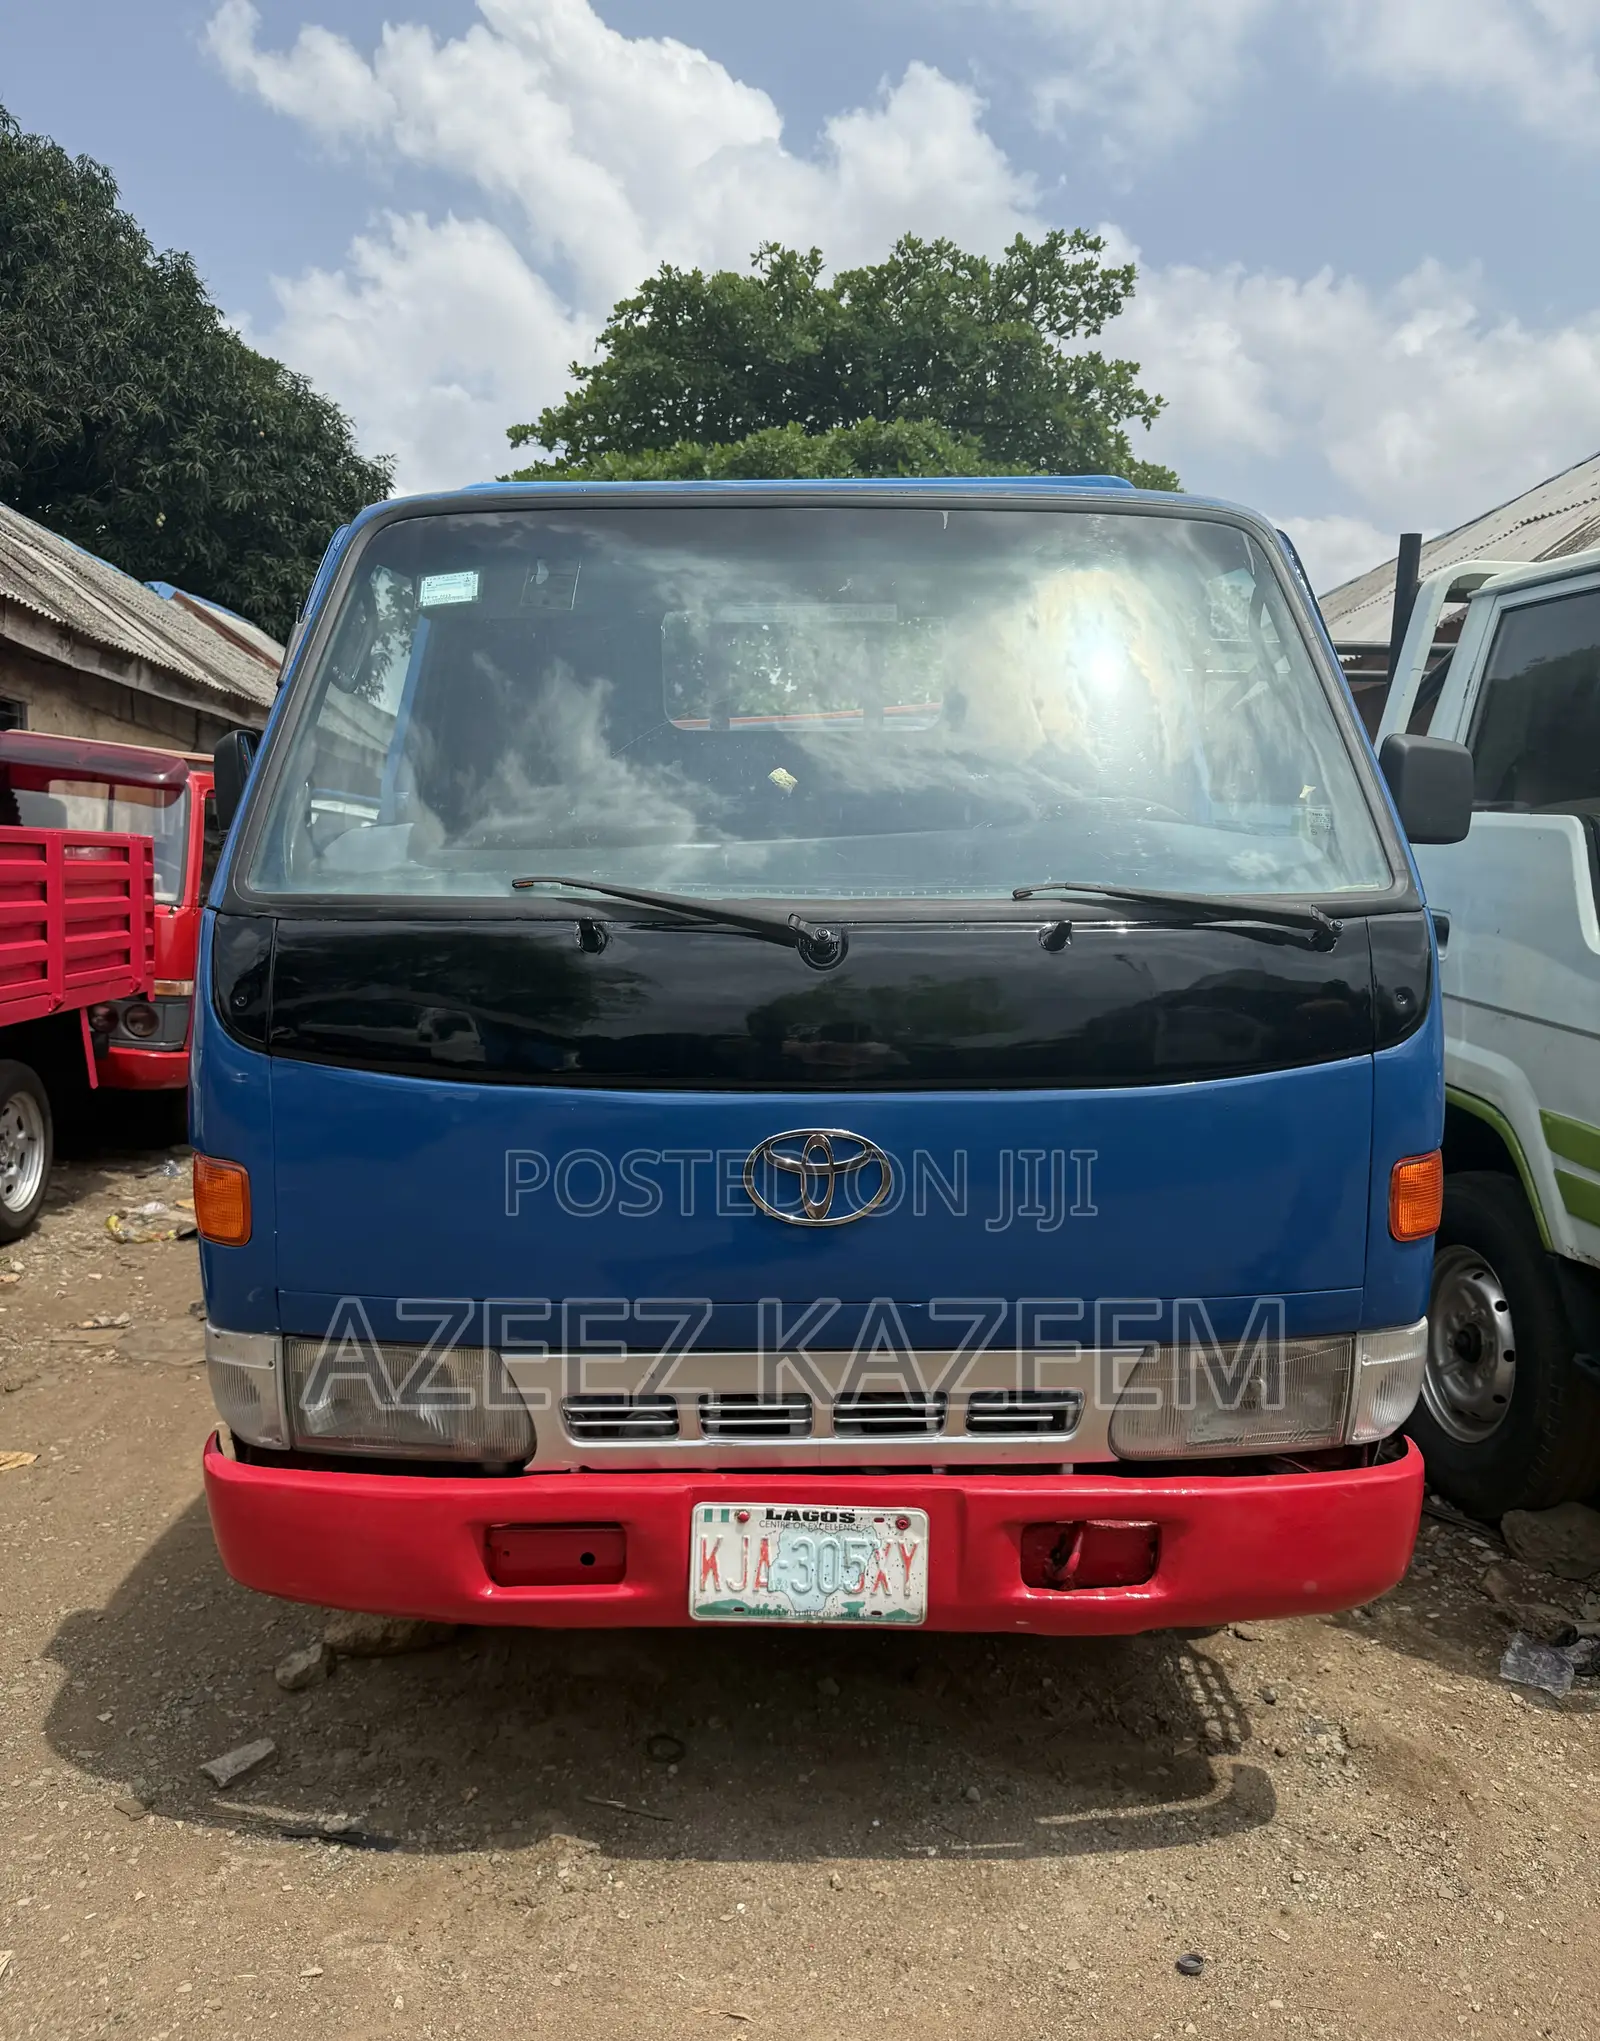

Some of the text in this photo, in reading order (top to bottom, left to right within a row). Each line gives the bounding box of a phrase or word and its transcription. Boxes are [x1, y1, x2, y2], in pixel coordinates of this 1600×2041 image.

[765, 1507, 856, 1524] LAGOS
[759, 1520, 792, 1529] CENTRE
[808, 1523, 861, 1532] EXCELLENCE
